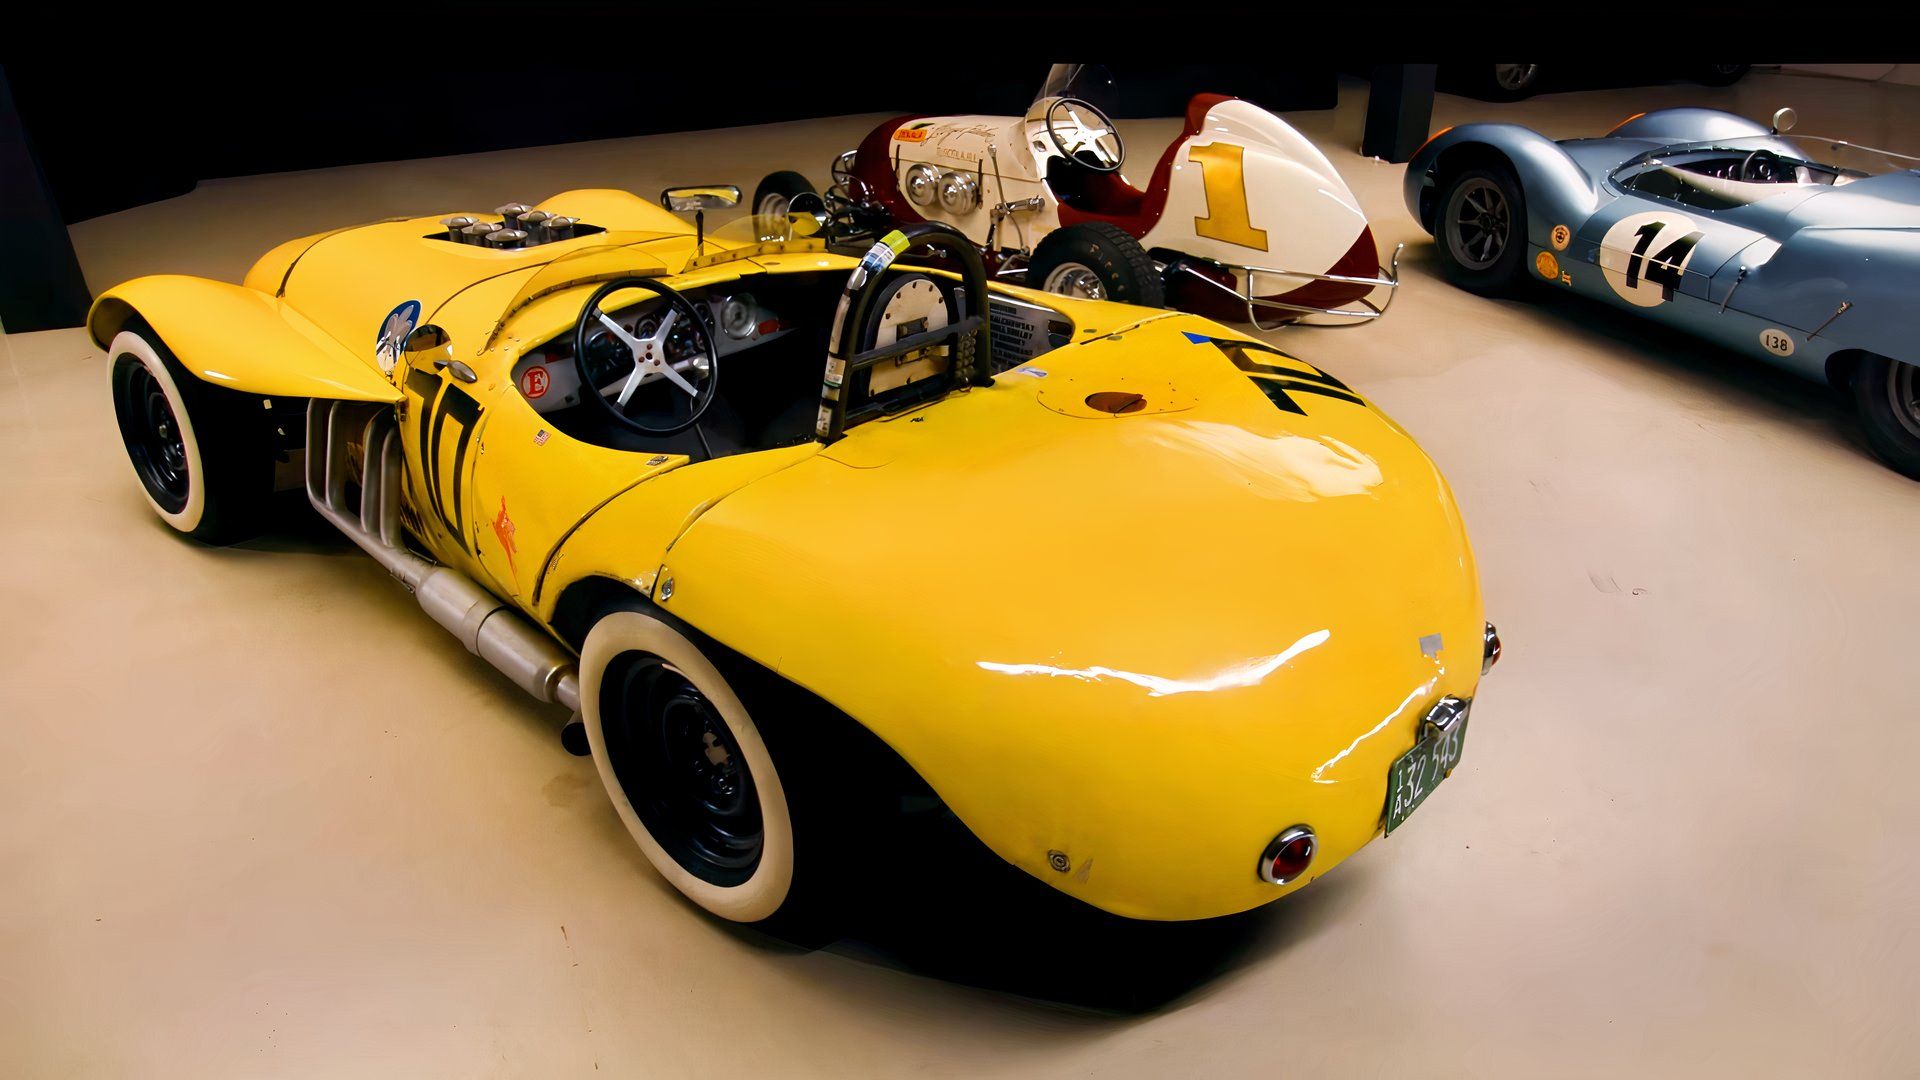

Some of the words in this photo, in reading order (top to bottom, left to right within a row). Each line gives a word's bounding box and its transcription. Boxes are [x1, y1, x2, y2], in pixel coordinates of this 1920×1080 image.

[1188, 141, 1268, 252] 1
[1626, 221, 1705, 302] 14
[1765, 334, 1788, 352] 138
[527, 370, 544, 396] E
